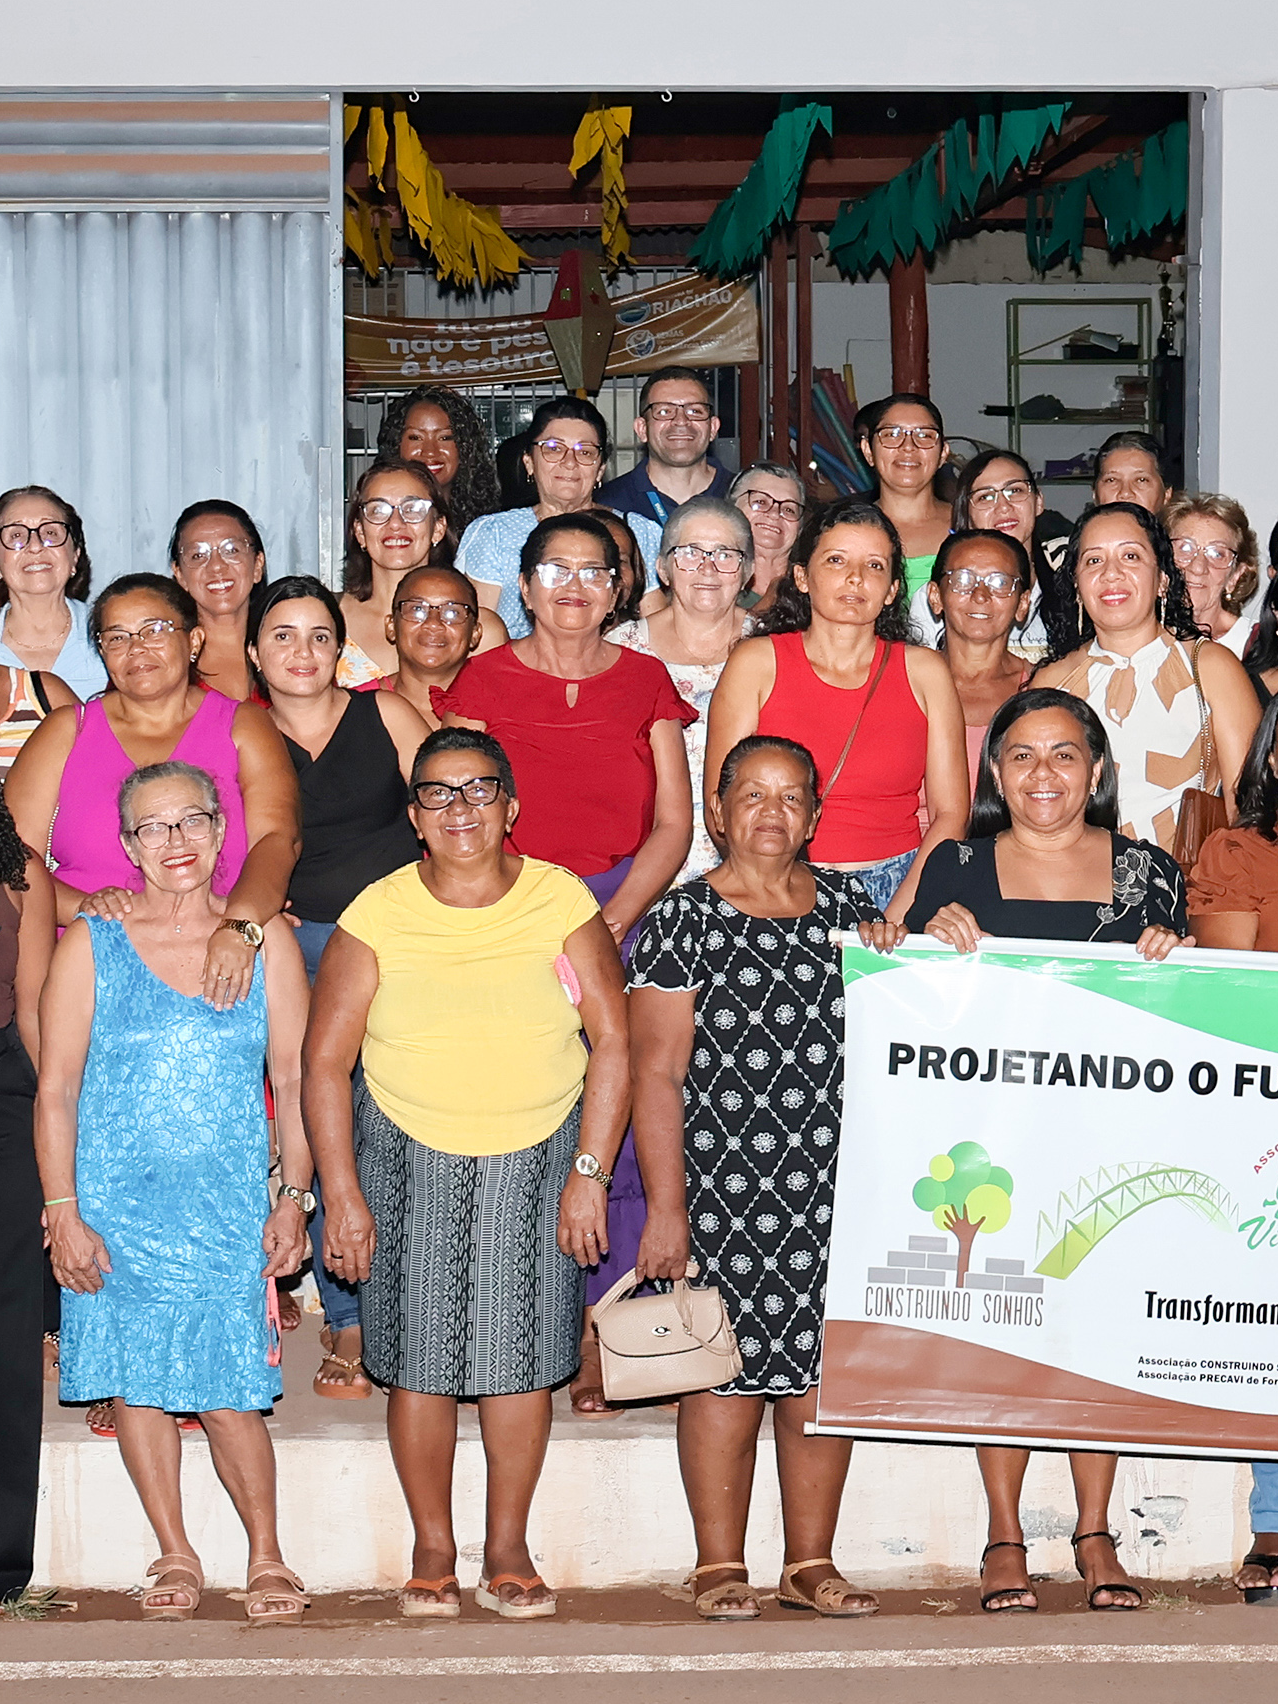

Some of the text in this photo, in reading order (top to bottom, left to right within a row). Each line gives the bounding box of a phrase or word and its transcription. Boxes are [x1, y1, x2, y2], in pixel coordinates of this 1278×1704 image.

[386, 334, 454, 354] não
[490, 331, 549, 355] pes
[399, 353, 421, 377] é
[888, 1042, 1174, 1093] PROJETANDO
[1188, 1061, 1219, 1095] O
[864, 1286, 1045, 1328] CONSTRUINDO SONHOS
[1137, 1355, 1198, 1369] Associação
[1200, 1359, 1274, 1372] CONSTRUINDO
[1137, 1369, 1197, 1383] Associação
[1199, 1374, 1244, 1384] PRECAVI
[1246, 1375, 1260, 1385] de
